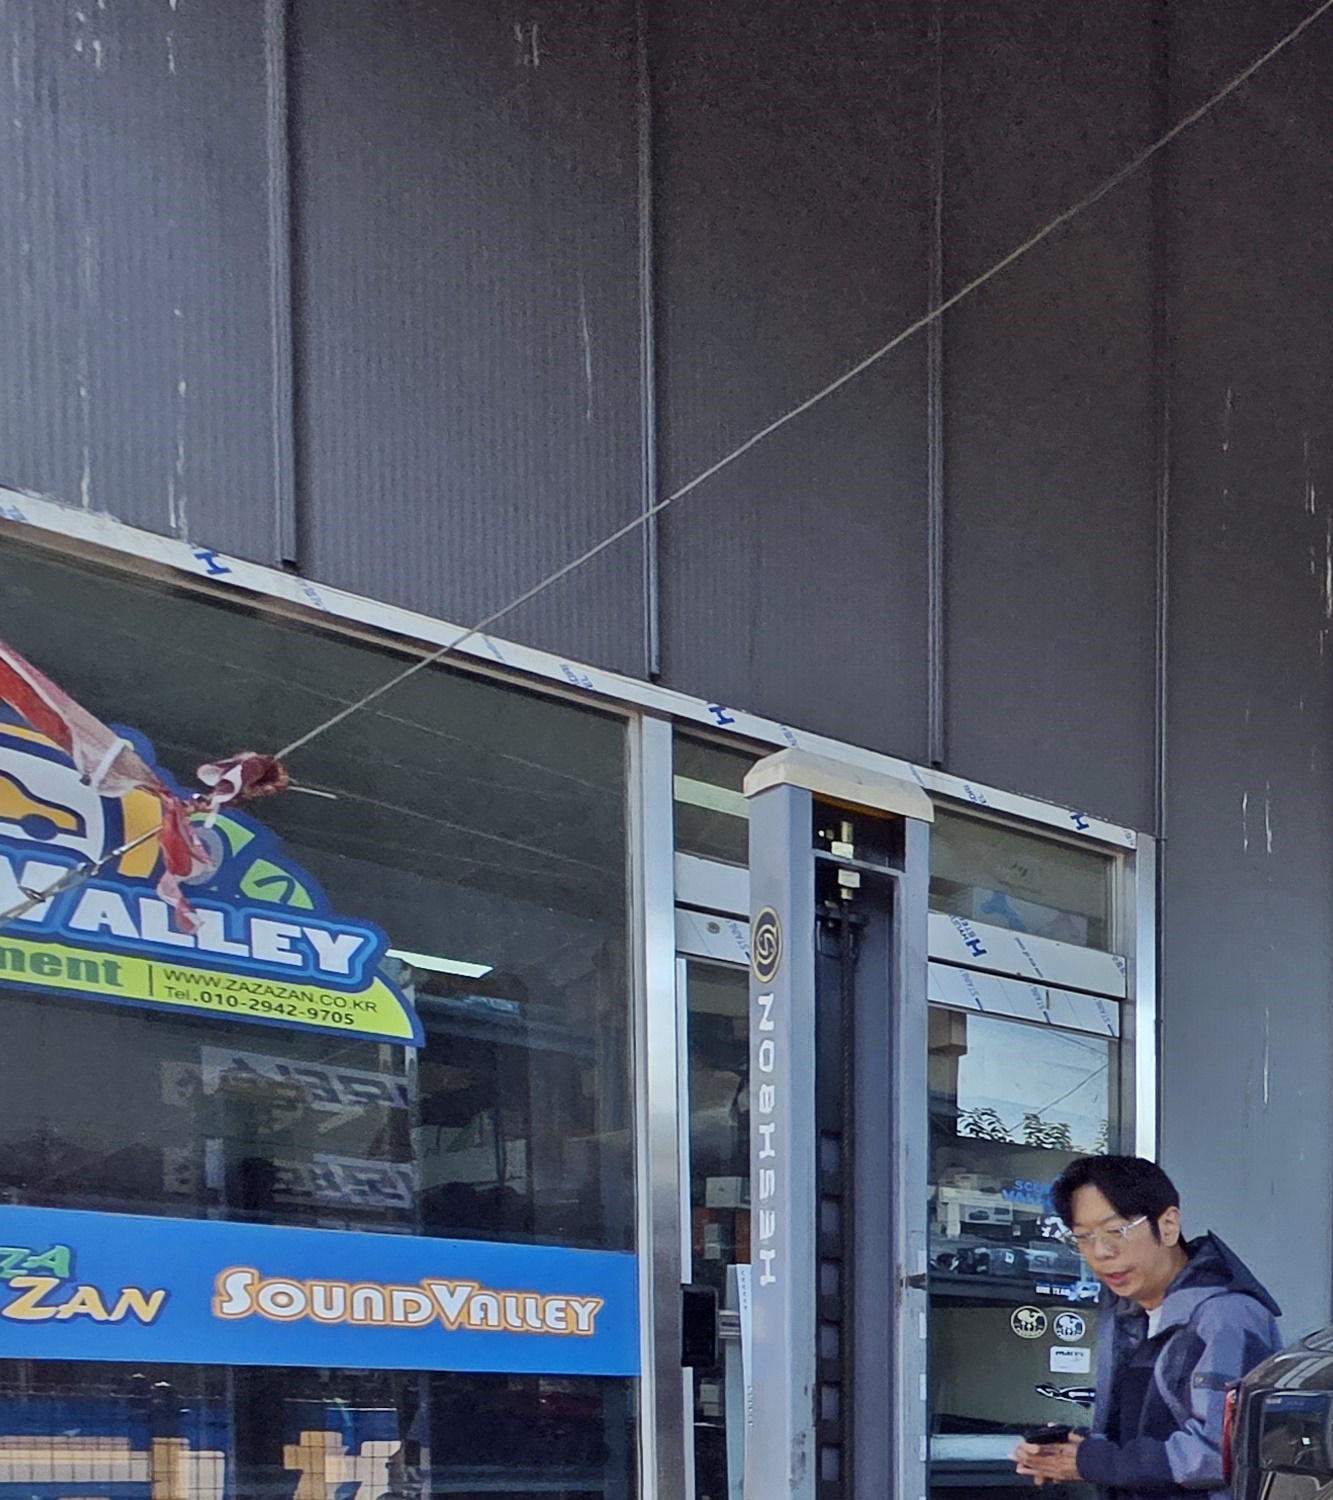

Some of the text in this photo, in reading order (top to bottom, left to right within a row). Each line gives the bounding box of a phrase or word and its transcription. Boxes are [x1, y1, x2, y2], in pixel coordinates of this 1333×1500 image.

[0, 856, 365, 975] VALLEY
[725, 920, 748, 950] STAINL
[163, 967, 378, 1014] WWW.ZAZAZAN.CO.KR
[958, 968, 978, 1002] STAINL
[1027, 983, 1047, 1013] STAINL
[1093, 996, 1111, 1025] STAINL
[1, 1276, 166, 1323] ZAN
